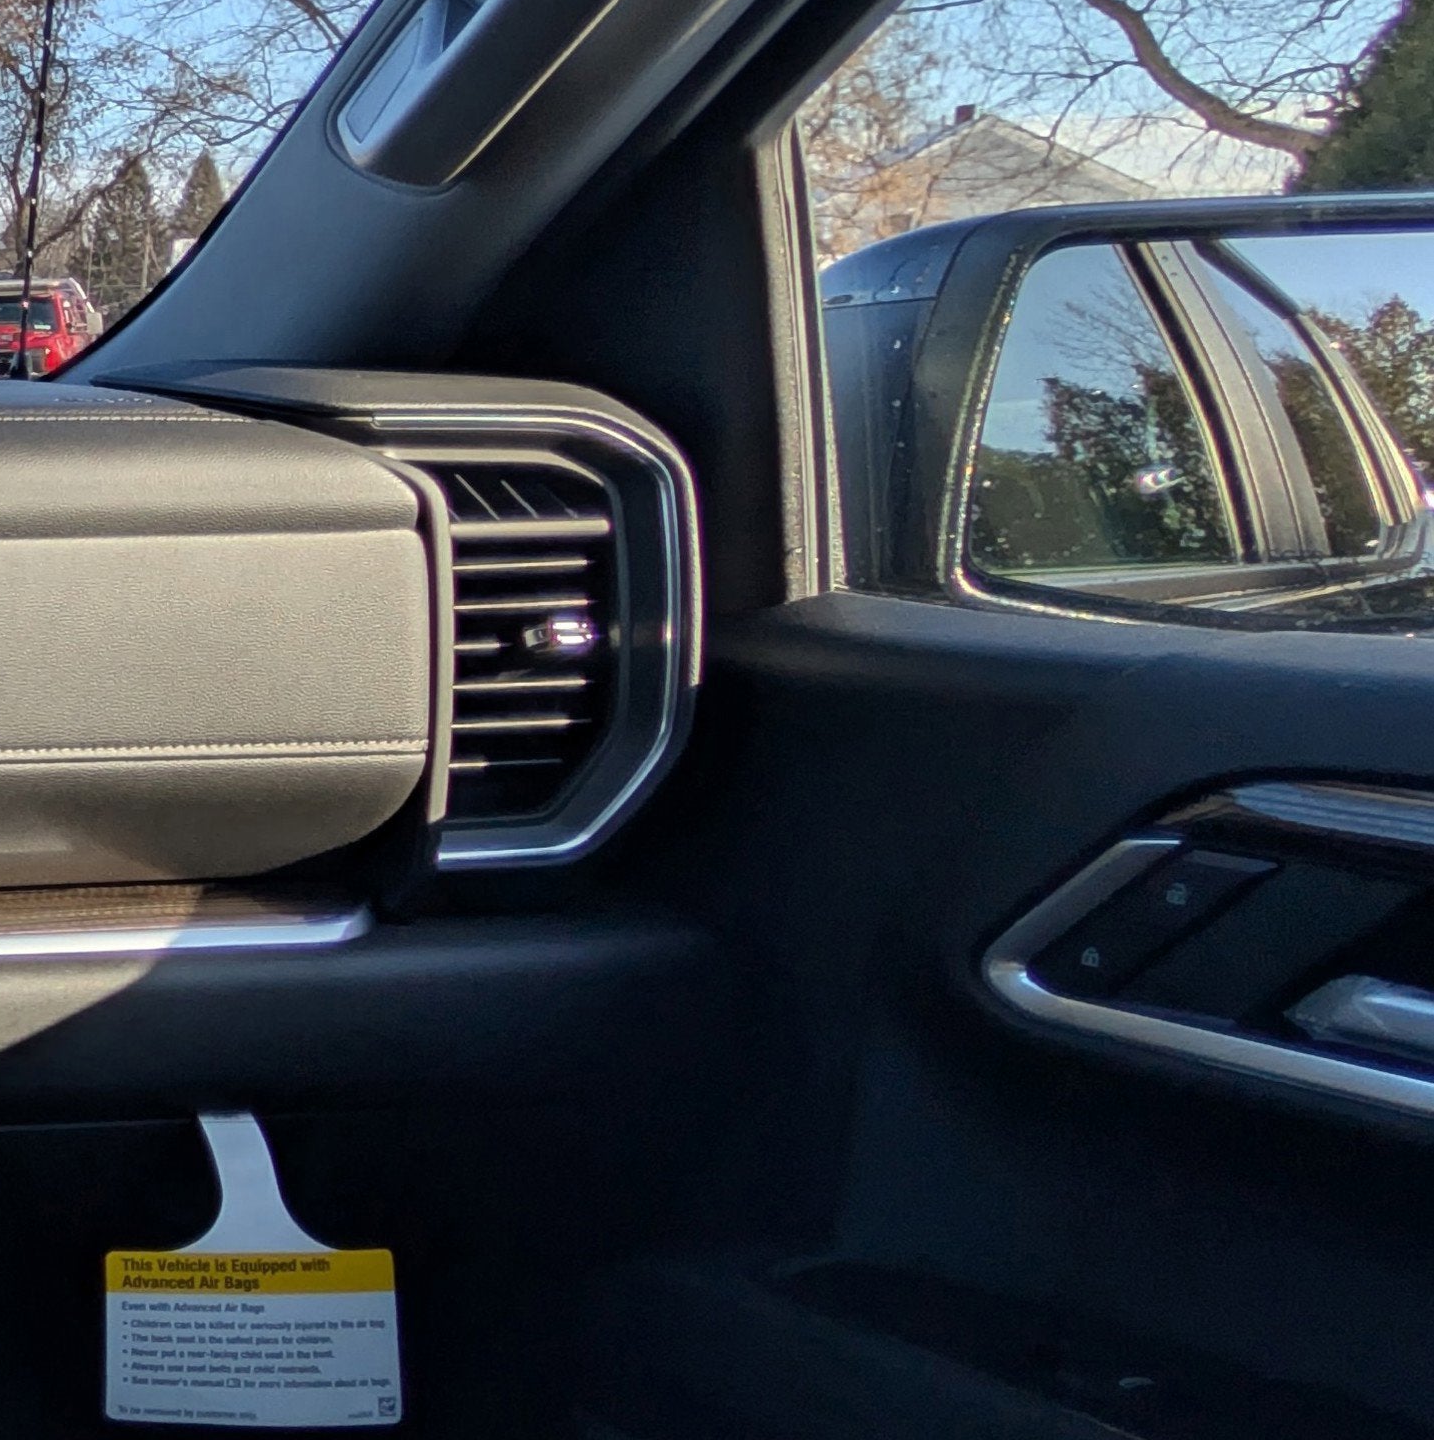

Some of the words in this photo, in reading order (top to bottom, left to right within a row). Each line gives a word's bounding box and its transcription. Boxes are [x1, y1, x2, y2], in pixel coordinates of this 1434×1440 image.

[122, 1258, 152, 1272] This
[157, 1259, 210, 1273] Vehicle
[215, 1259, 227, 1273] is
[231, 1259, 296, 1275] Equipped
[299, 1258, 331, 1272] with
[122, 1275, 194, 1289] Advanced
[199, 1276, 219, 1289] Air
[224, 1276, 260, 1292] Bags
[122, 1302, 146, 1312] Even
[148, 1302, 172, 1312] with
[174, 1302, 222, 1312] Advanced
